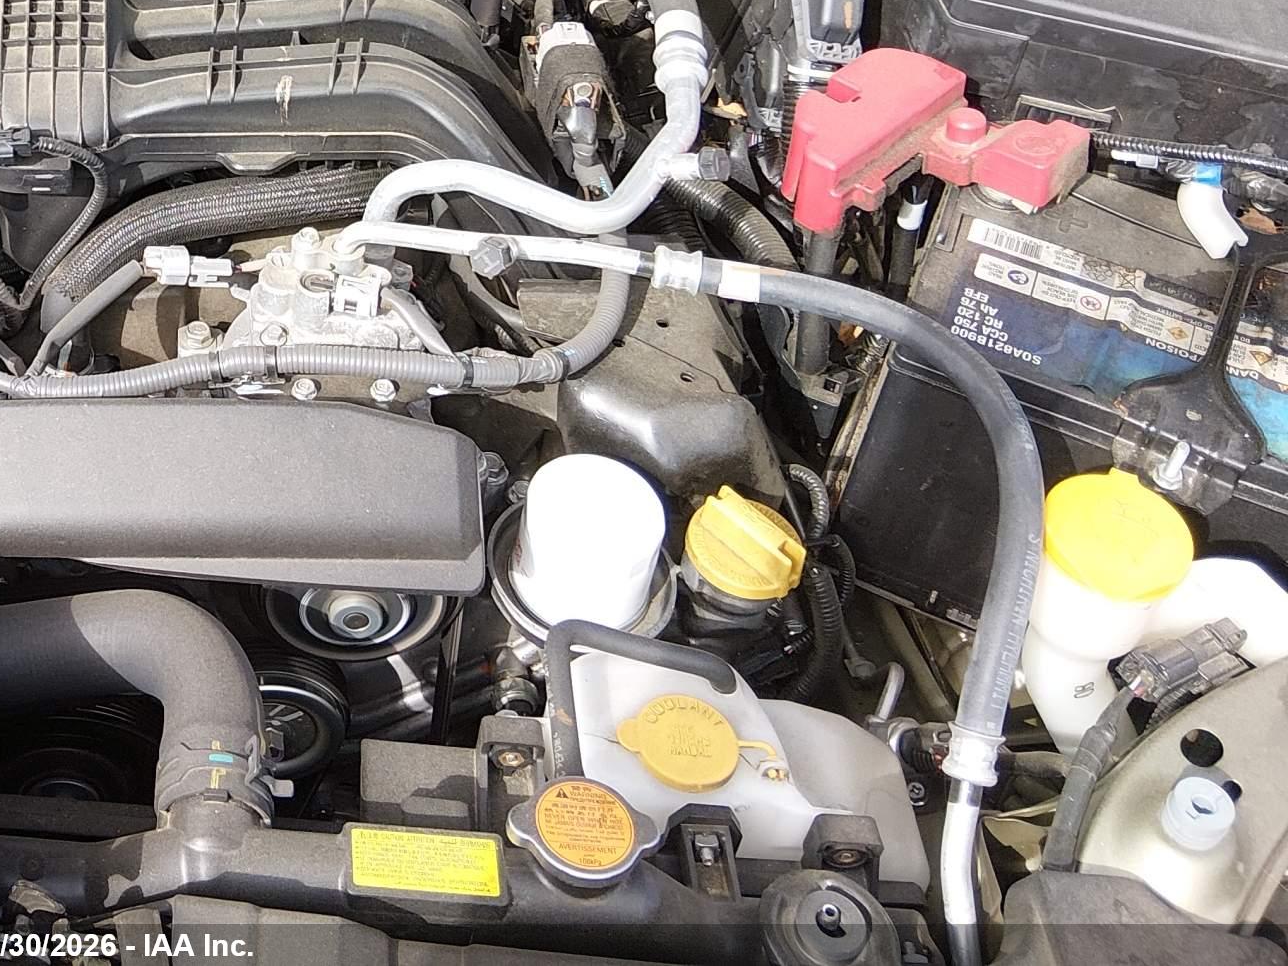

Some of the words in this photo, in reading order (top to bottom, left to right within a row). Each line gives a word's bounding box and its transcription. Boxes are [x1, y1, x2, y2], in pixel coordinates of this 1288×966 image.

[963, 287, 990, 303] EFB
[959, 296, 976, 310] 76
[979, 303, 999, 316] Ah
[956, 305, 981, 321] 120
[953, 315, 980, 331] 750
[982, 316, 1004, 329] RC
[981, 326, 1009, 343] CCA
[1226, 366, 1259, 380] DAN
